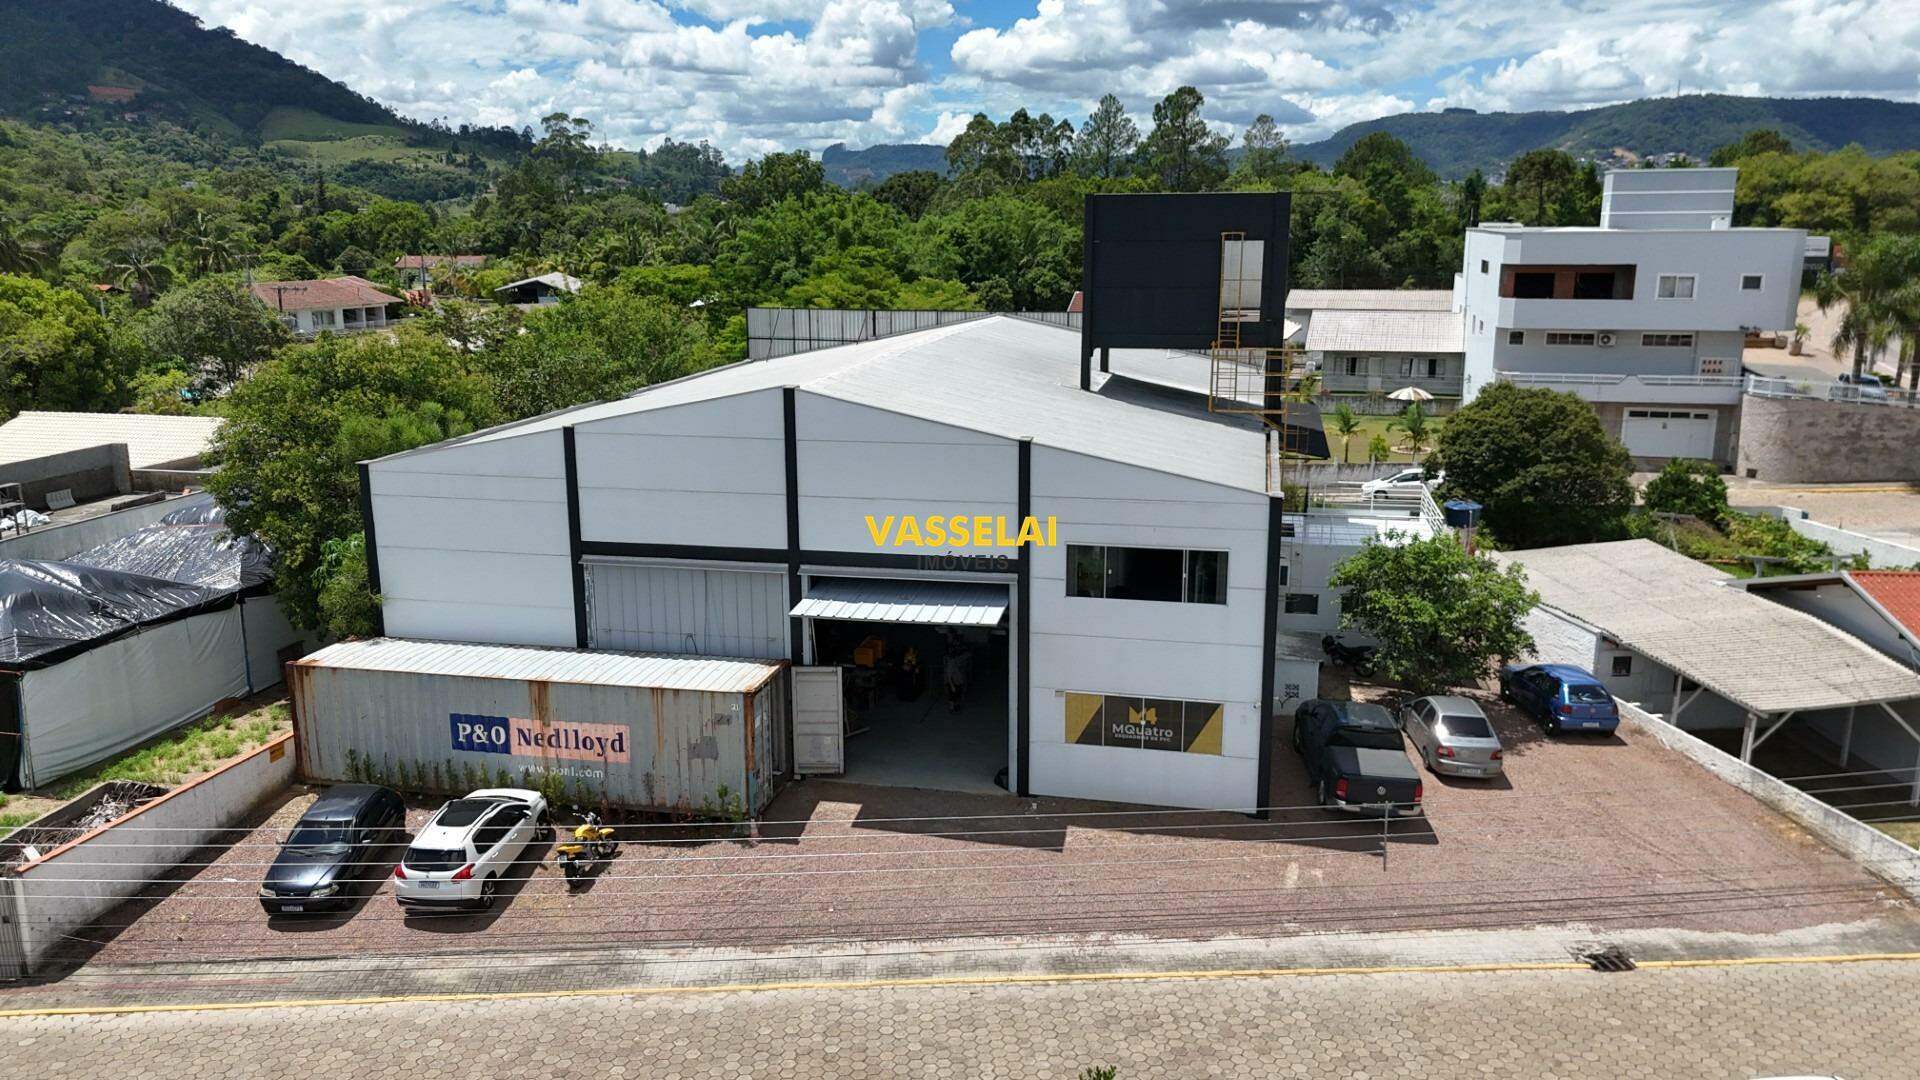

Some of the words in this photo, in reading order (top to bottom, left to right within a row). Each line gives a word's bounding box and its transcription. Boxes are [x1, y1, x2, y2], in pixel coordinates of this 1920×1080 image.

[1112, 723, 1174, 738] MQuatro
[457, 722, 506, 745] P&O
[516, 727, 626, 757] Nedlloyd
[519, 764, 604, 779] wwwonl.com
